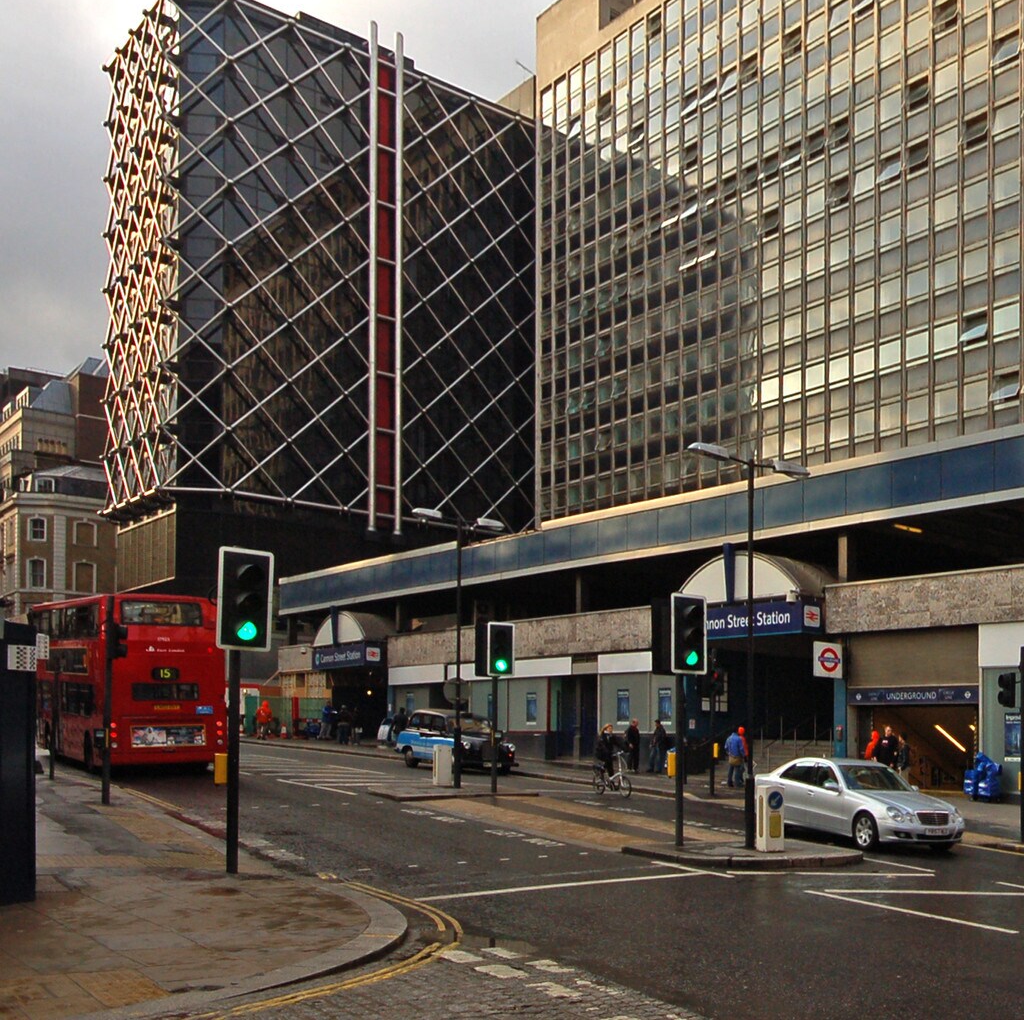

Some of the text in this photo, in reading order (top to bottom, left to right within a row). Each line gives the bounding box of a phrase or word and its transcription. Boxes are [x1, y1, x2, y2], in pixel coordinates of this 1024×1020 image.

[705, 618, 726, 630] nnon
[756, 611, 791, 626] Station
[334, 651, 347, 662] Street
[347, 650, 361, 661] Station
[160, 668, 171, 678] 15
[886, 691, 937, 700] UNDERGROUND
